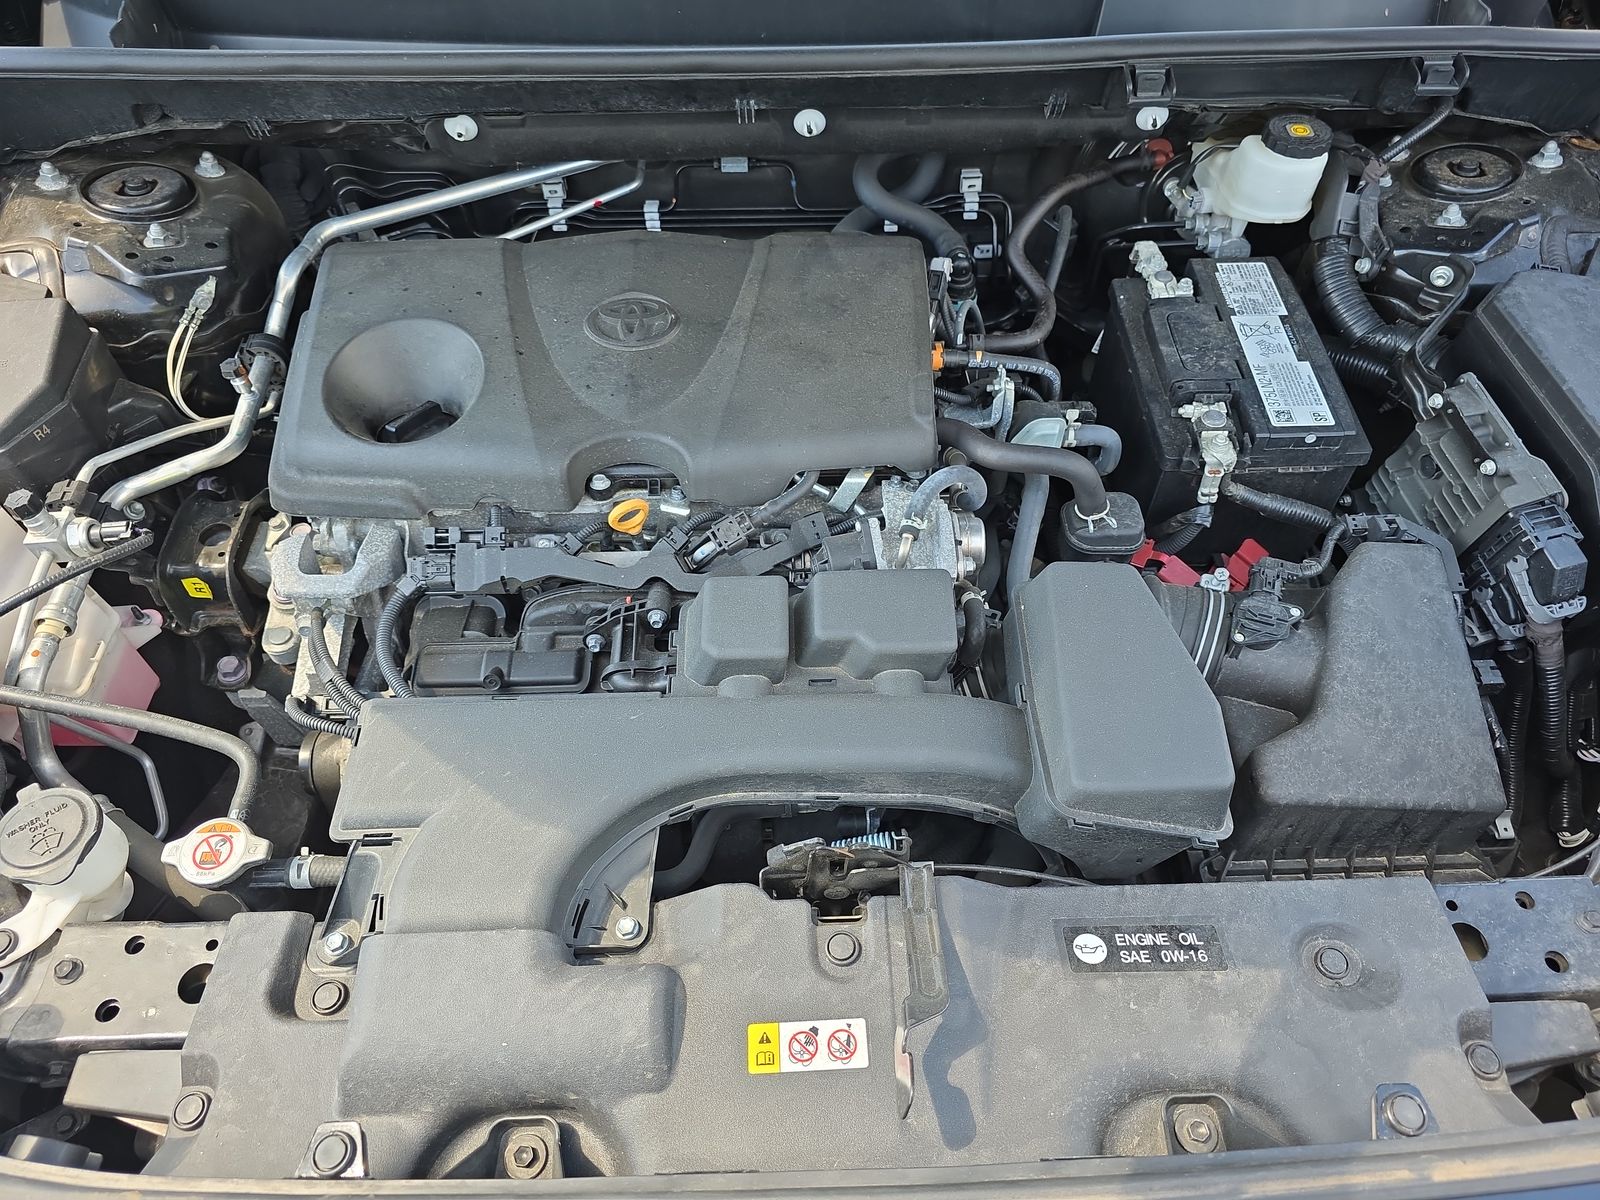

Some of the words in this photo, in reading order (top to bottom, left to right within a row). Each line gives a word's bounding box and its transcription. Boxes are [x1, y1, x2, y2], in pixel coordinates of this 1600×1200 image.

[1253, 364, 1281, 408] 375LN2-MF
[1314, 412, 1328, 422] SP
[32, 424, 51, 441] R4
[191, 582, 207, 593] R1
[6, 817, 41, 838] WASHER
[44, 803, 68, 817] FLUID
[29, 818, 49, 833] ONLY
[1115, 933, 1170, 946] ENGINE
[1178, 932, 1204, 945] OIL
[1119, 950, 1151, 963] SAE
[1161, 950, 1208, 963] 0W-16
